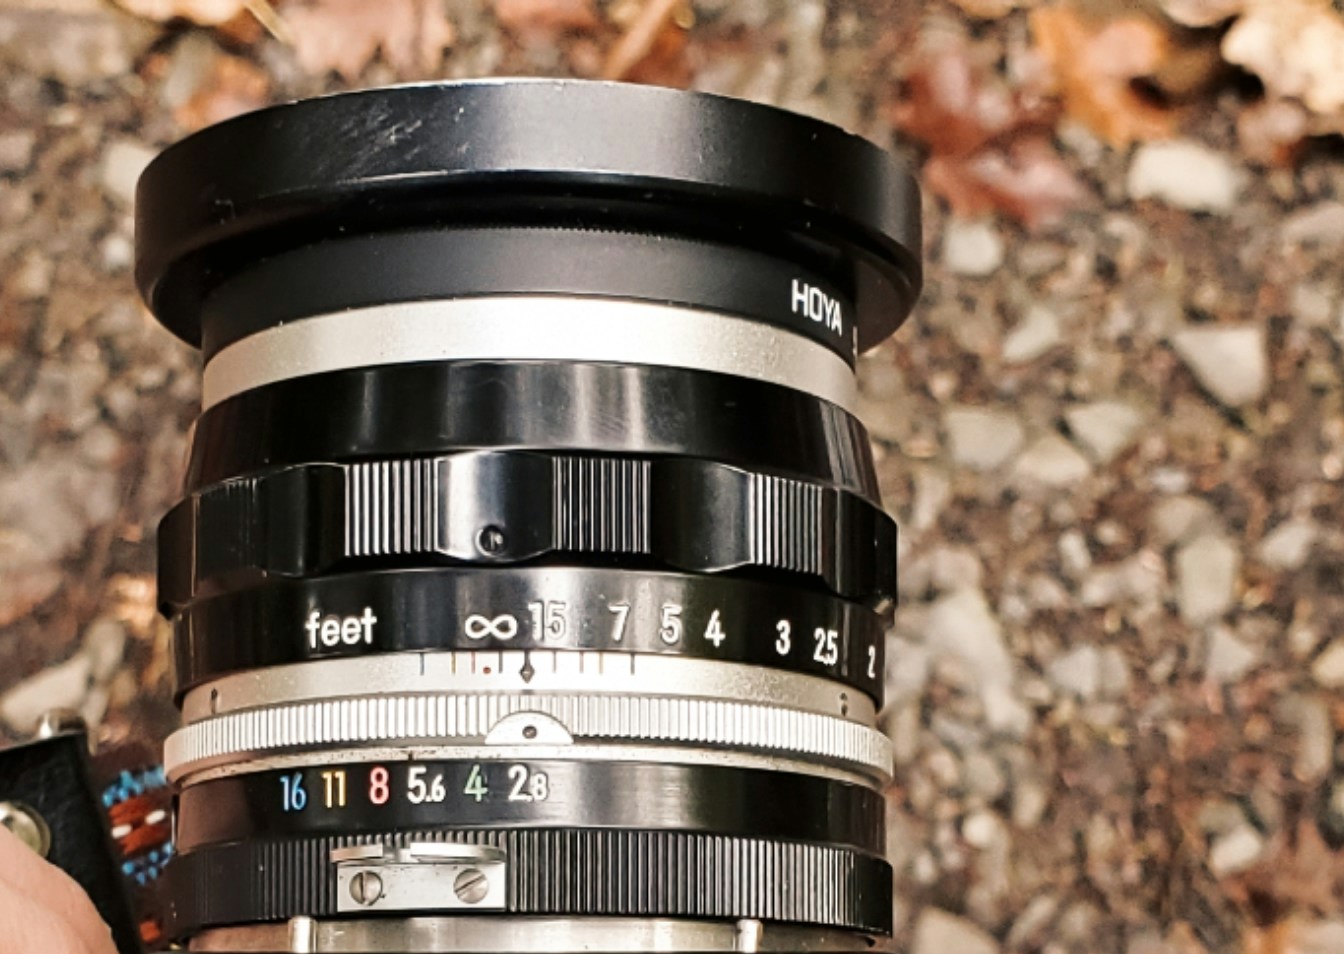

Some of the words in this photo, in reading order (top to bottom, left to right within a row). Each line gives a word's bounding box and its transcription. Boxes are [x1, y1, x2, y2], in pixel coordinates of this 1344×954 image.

[791, 278, 842, 337] HOYA
[305, 606, 378, 649] feet
[527, 602, 567, 642] 15
[608, 603, 630, 641] 7
[659, 603, 683, 644] 5
[704, 609, 726, 648] 4
[775, 619, 792, 656] 3
[868, 645, 876, 679] 2
[280, 772, 307, 812] 16
[321, 770, 347, 808] 11
[369, 766, 390, 805] 8
[407, 765, 447, 804] 5.6
[464, 764, 489, 802] 4
[508, 764, 550, 802] 2.8
